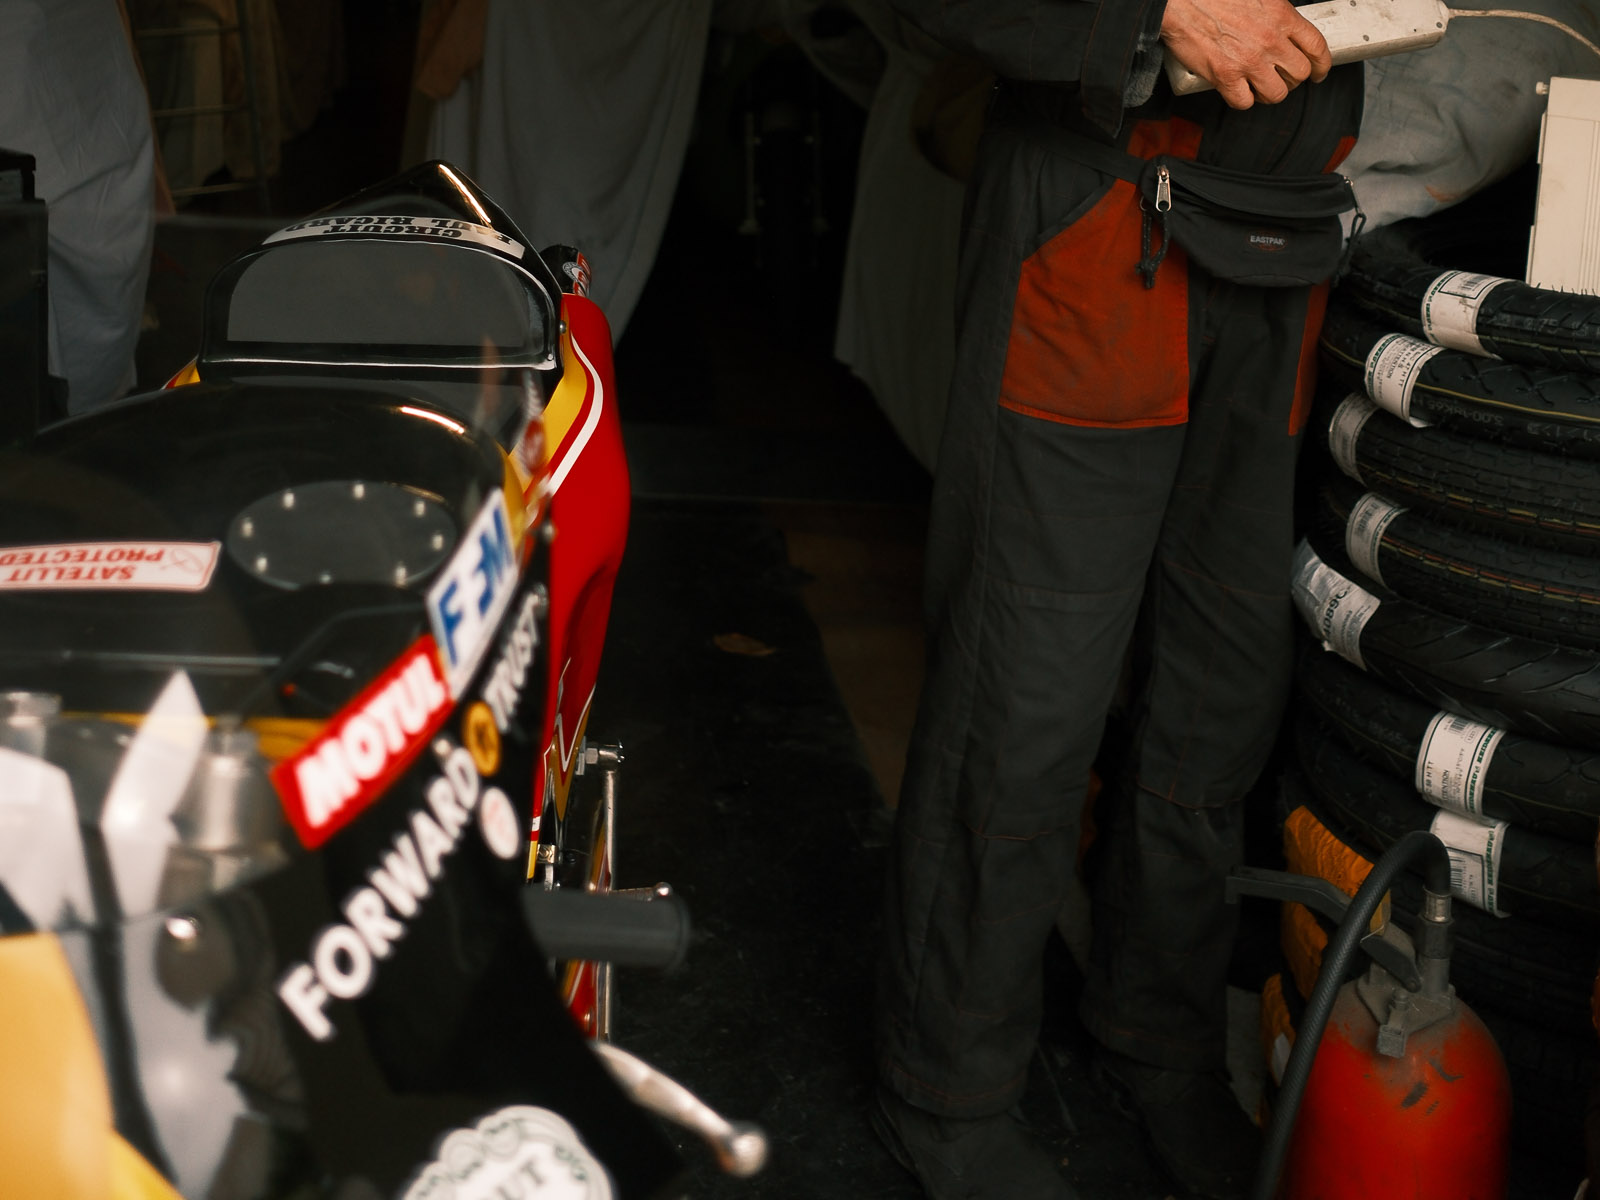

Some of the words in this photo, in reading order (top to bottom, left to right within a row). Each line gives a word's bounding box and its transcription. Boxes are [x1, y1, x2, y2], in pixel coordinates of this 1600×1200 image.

[285, 216, 413, 232] RICARD
[322, 225, 463, 238] CIRCUIT
[1250, 234, 1284, 245] EASTPAK
[0, 548, 166, 567] PROTECTED
[4, 565, 137, 582] SATELLIT
[296, 652, 449, 829] MOTUL
[278, 745, 480, 1042] FORWARD
